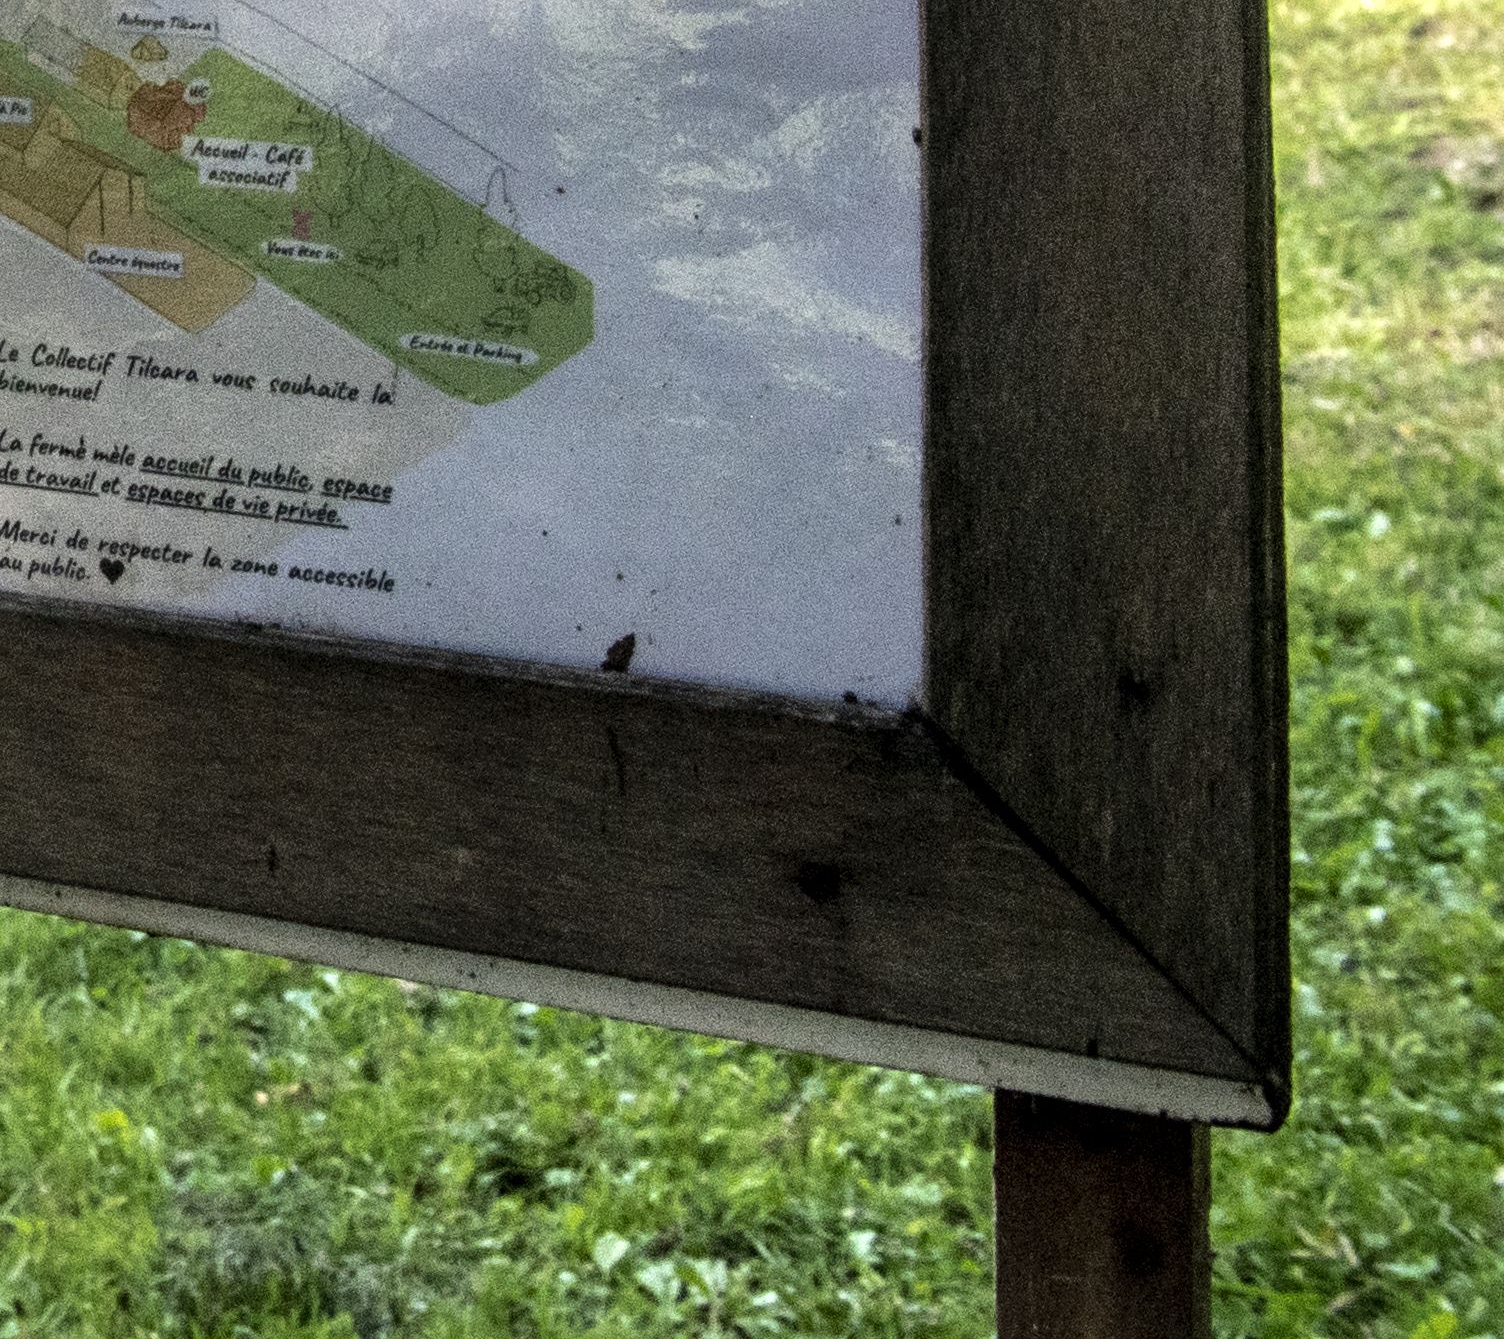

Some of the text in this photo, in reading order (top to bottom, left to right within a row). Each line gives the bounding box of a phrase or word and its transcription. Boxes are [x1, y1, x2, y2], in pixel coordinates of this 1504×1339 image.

[190, 84, 209, 98] WC
[190, 139, 250, 161] Accueil
[265, 146, 304, 165] Café
[209, 170, 291, 188] associatif
[88, 250, 181, 272] Centre équestre
[268, 241, 294, 256] Vous
[473, 342, 523, 364] Parking
[32, 343, 115, 374] Collectif
[126, 355, 199, 382] Tilcara
[213, 372, 254, 390] vous
[270, 375, 359, 401] souhaite
[372, 383, 394, 406] la
[142, 450, 213, 476] accueil
[218, 459, 243, 481] du
[248, 463, 315, 492] public,
[321, 476, 394, 500] espace
[25, 467, 96, 491] travail
[101, 477, 120, 495] et
[127, 481, 206, 508] espaces
[213, 487, 235, 510] de
[242, 495, 270, 515] vie
[274, 500, 343, 526] privée.
[0, 554, 91, 581] au public.
[66, 528, 89, 551] de
[98, 536, 193, 565] respecter
[202, 547, 222, 569] la
[231, 557, 278, 577] zone
[288, 565, 395, 594] accessible
